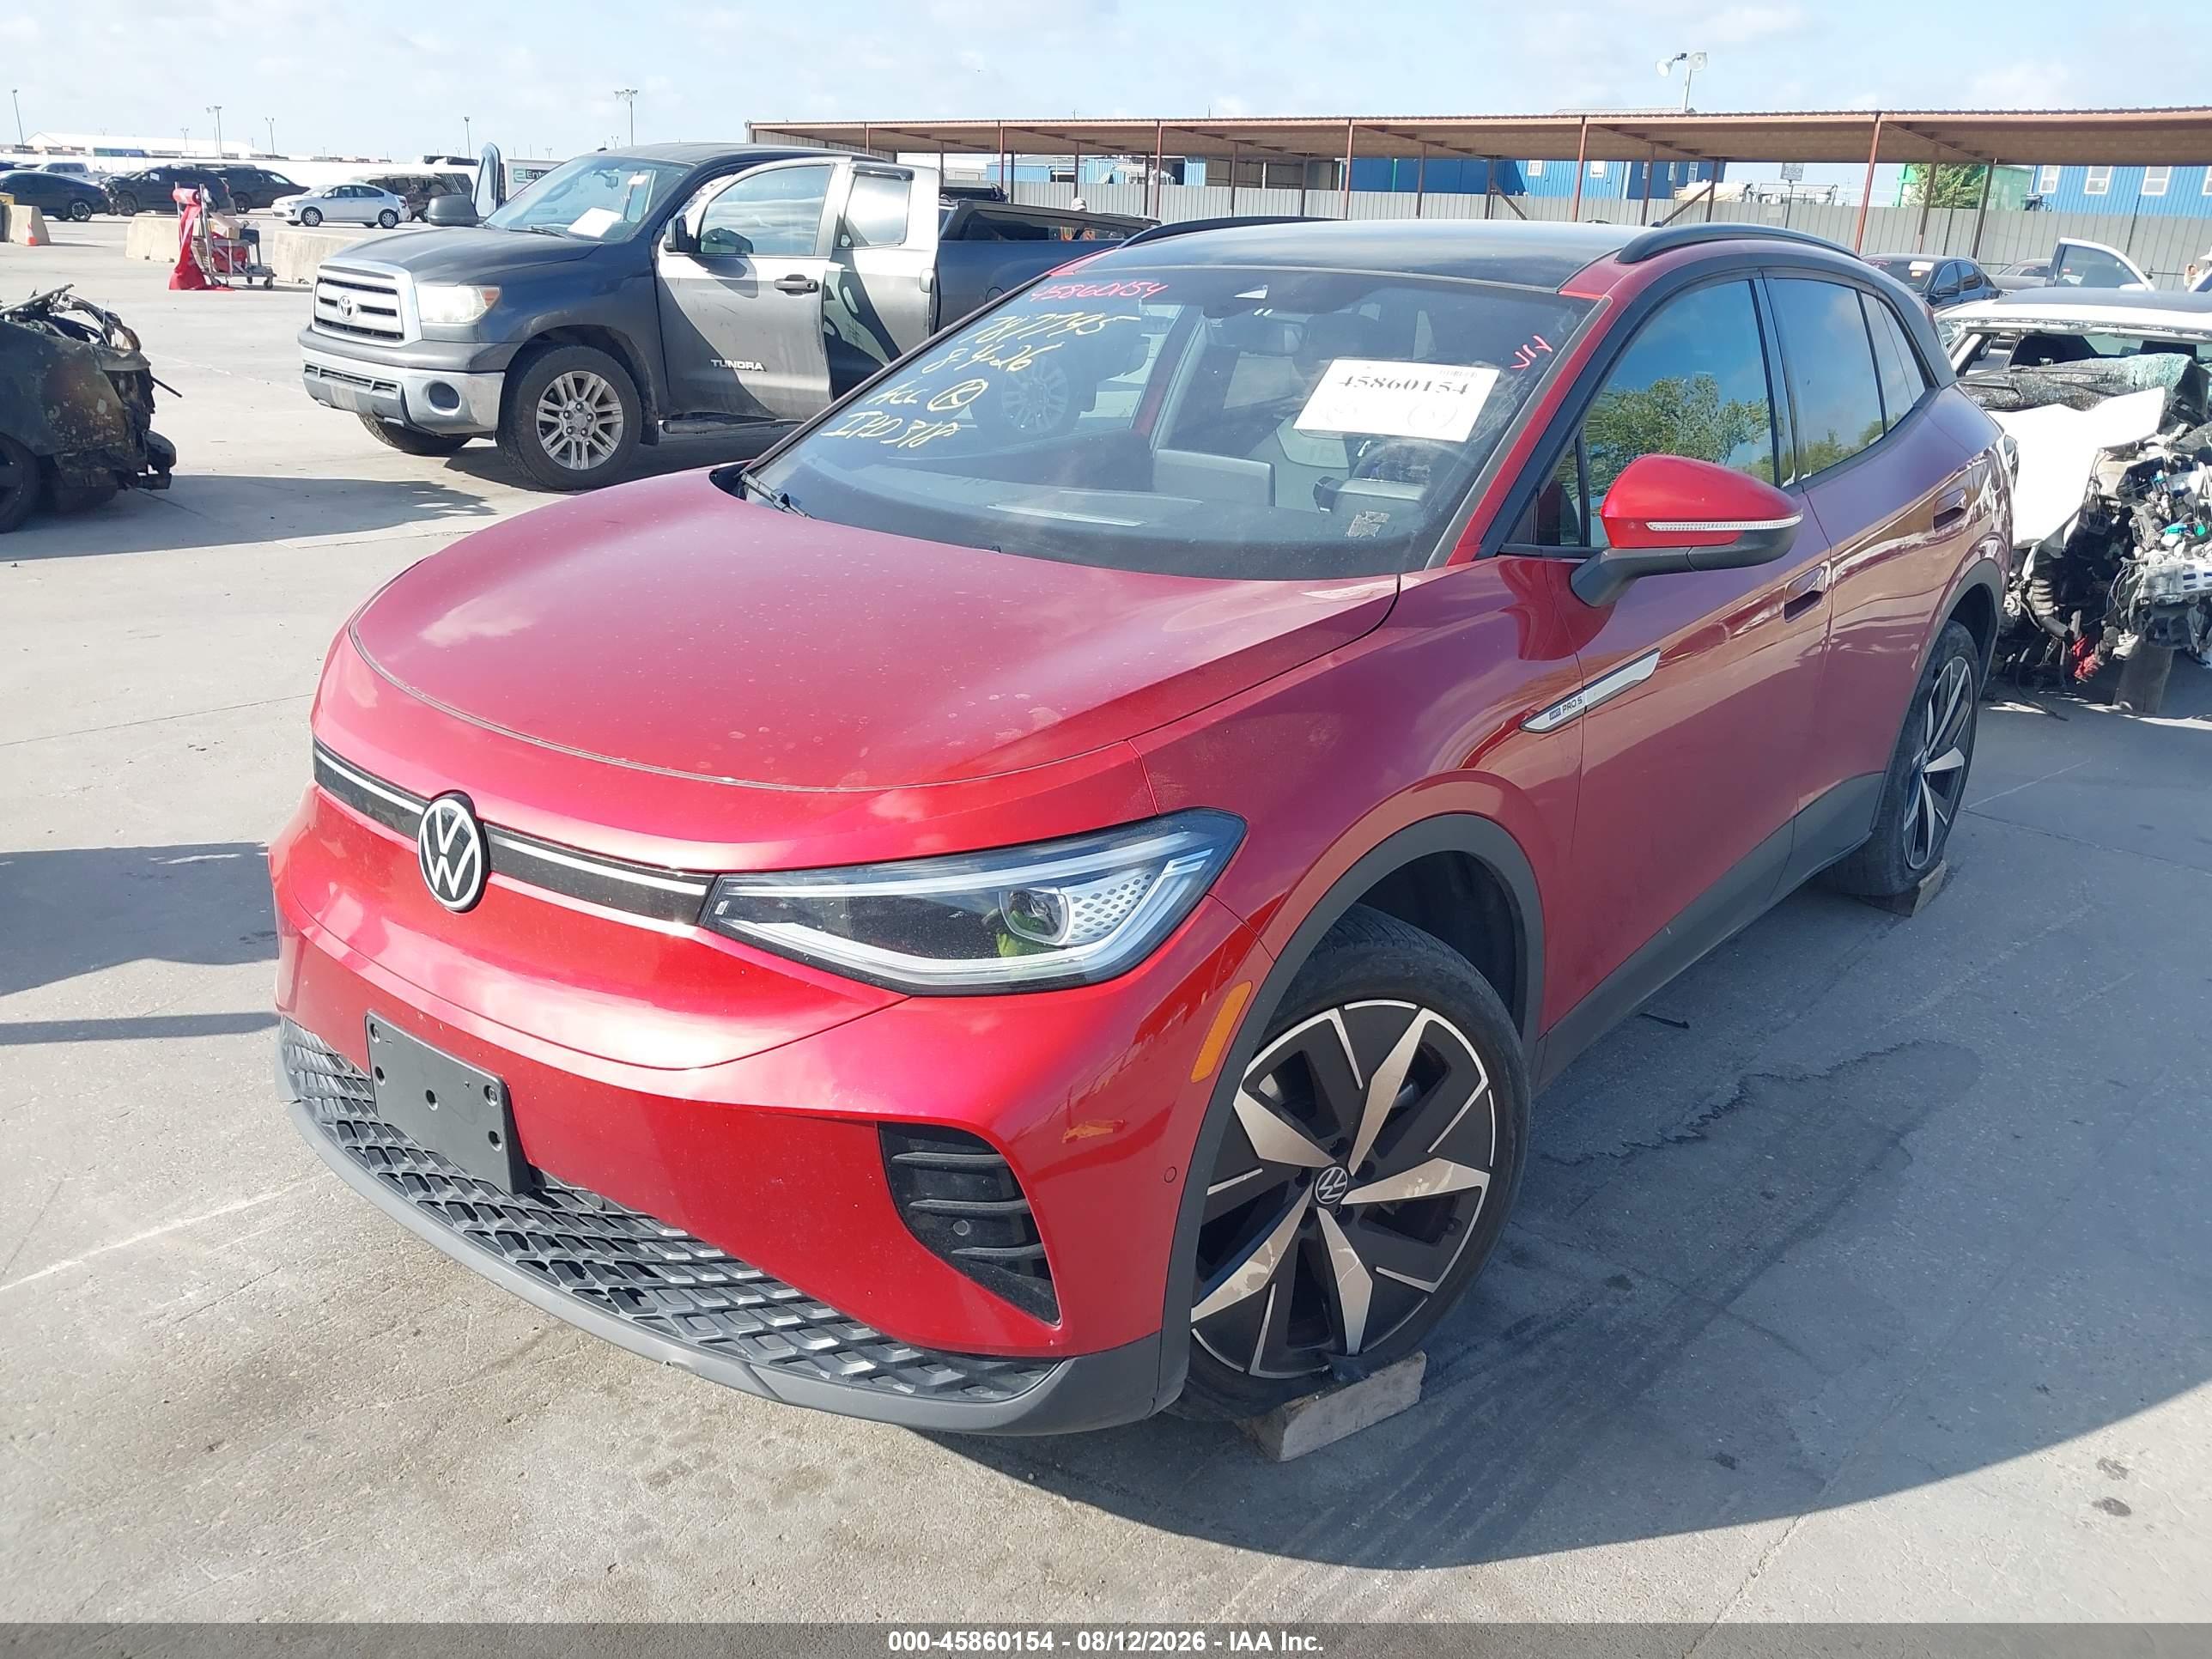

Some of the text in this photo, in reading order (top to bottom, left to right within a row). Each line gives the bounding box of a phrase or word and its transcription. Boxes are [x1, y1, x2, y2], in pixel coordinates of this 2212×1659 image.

[526, 170, 546, 179] Ent
[1030, 281, 1169, 301] 45860154
[710, 359, 764, 371] TUNDRA
[1338, 376, 1469, 395] 45860154
[1562, 700, 1577, 714] PRO
[1577, 696, 1583, 705] S
